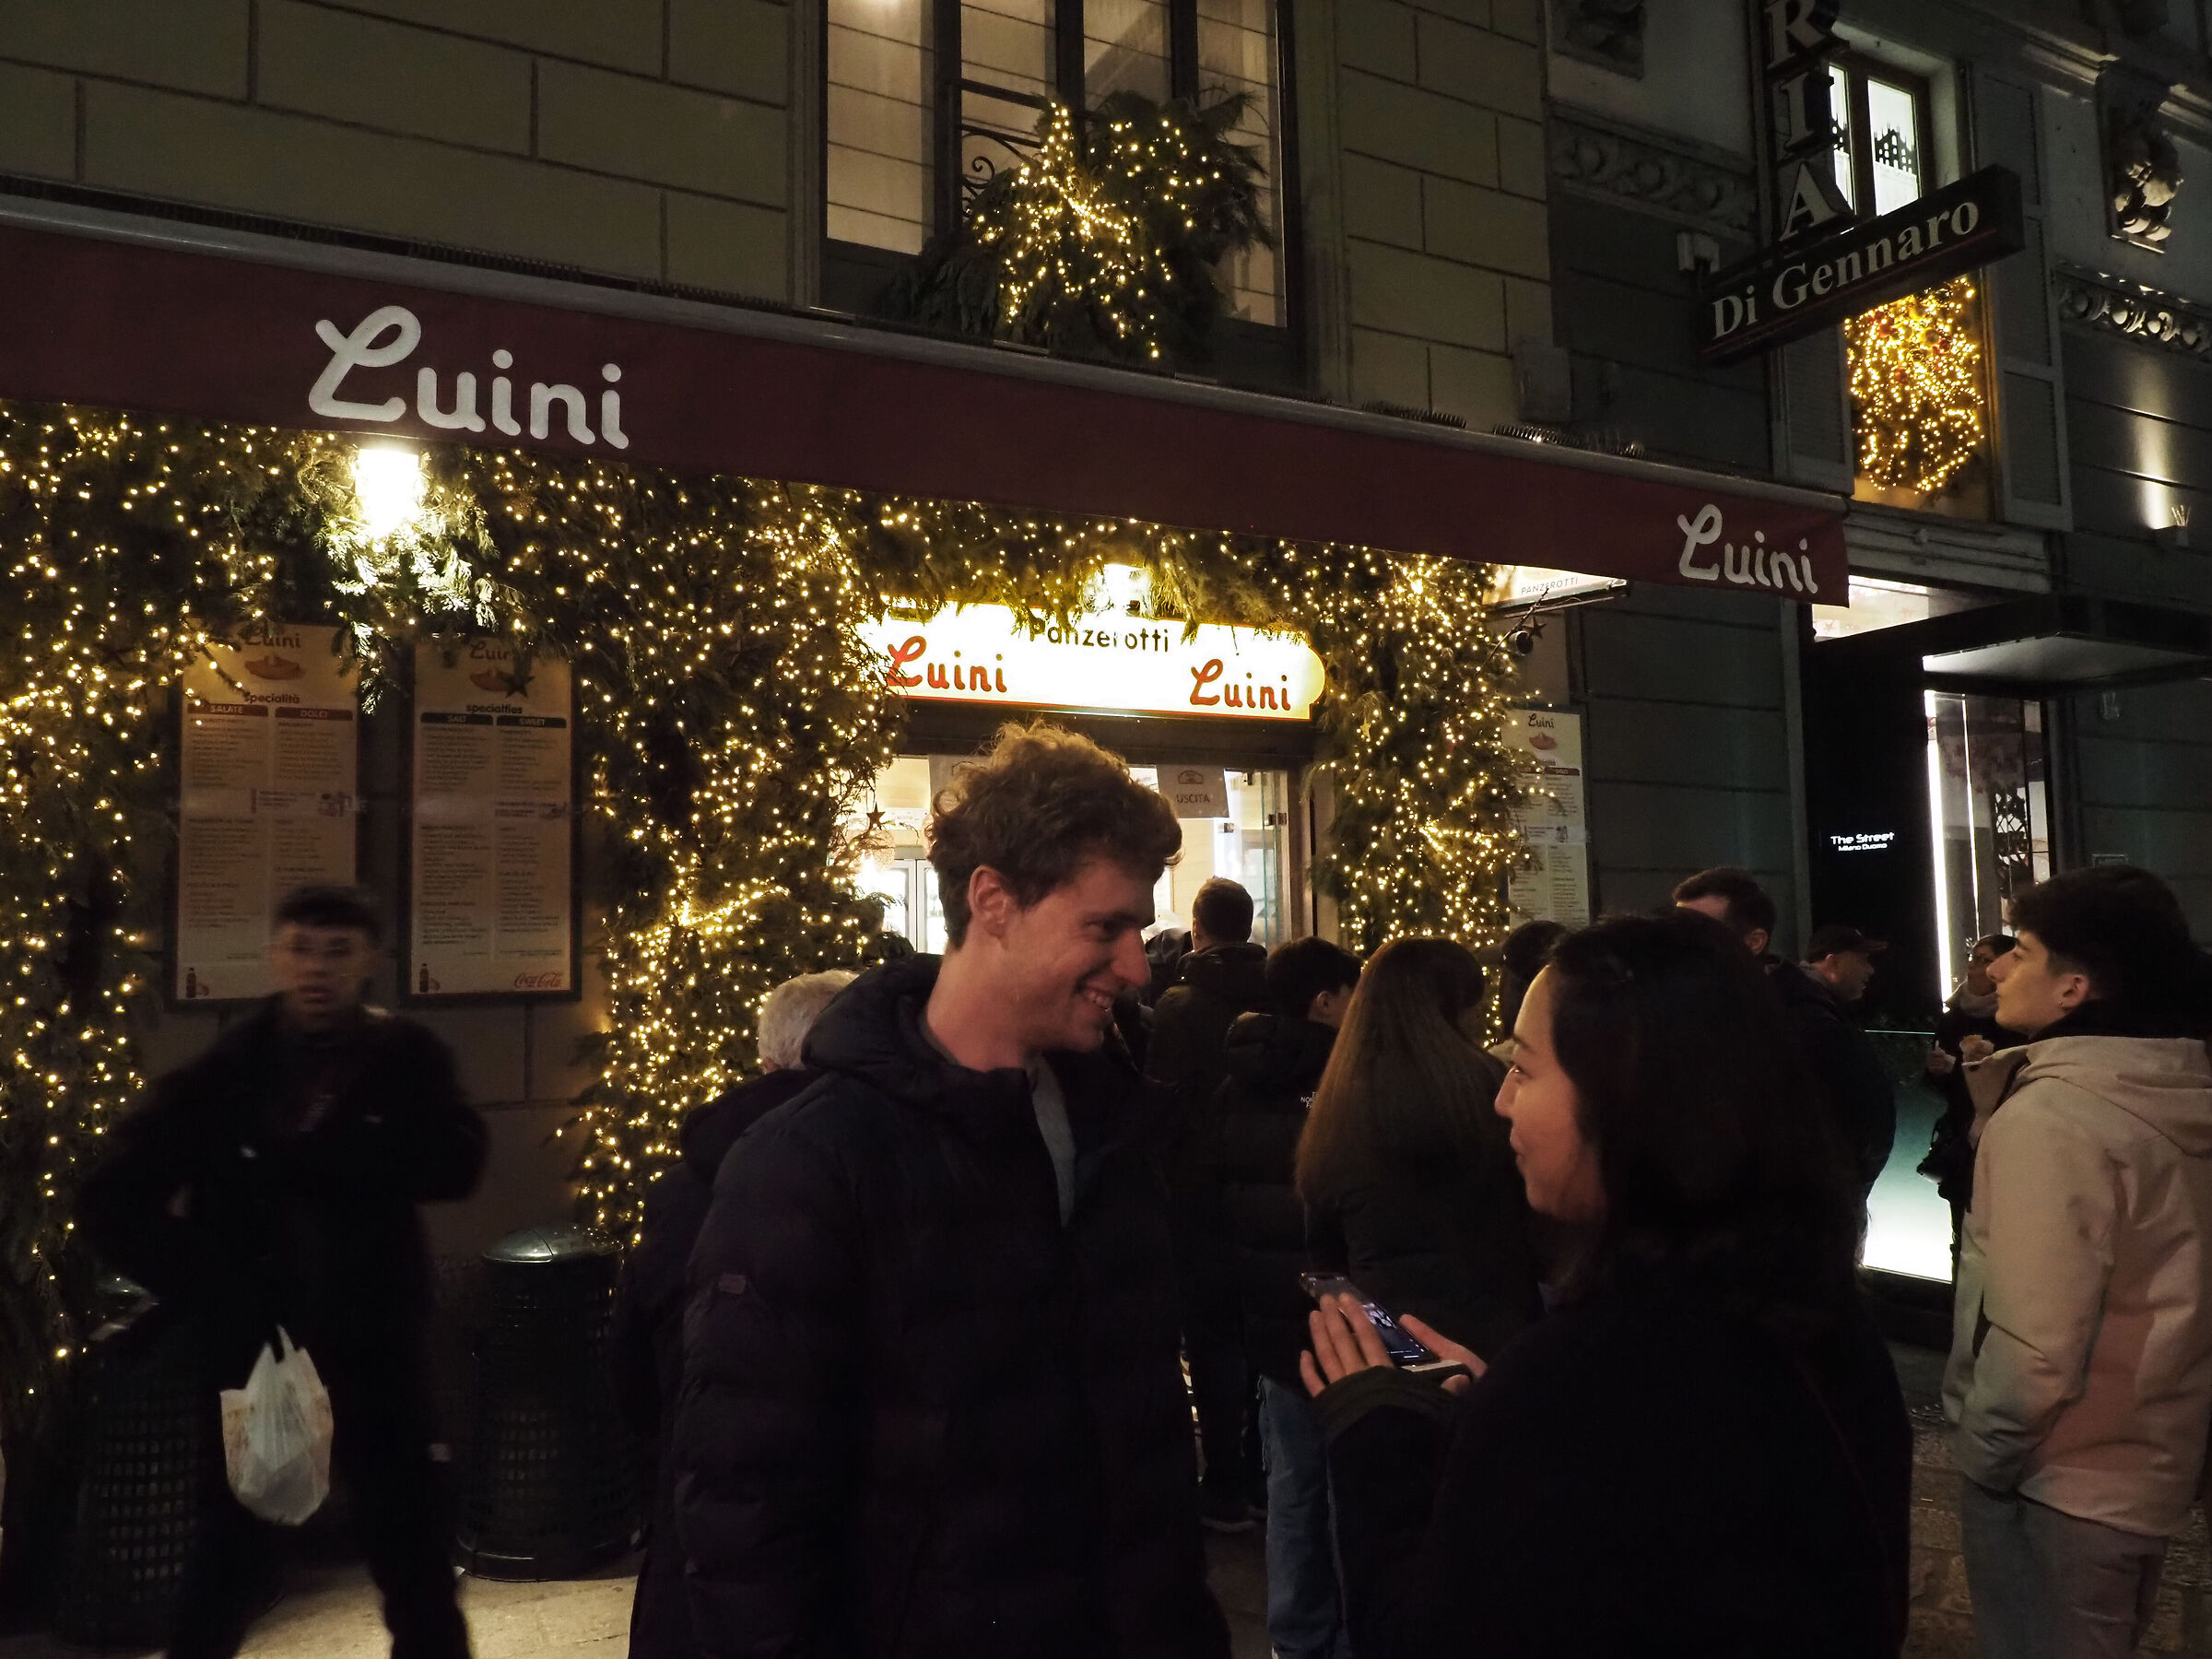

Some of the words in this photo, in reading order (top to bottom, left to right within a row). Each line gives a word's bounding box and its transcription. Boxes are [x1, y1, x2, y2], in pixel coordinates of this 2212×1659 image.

[1712, 285, 1759, 339] Di
[1772, 201, 1980, 311] Gennaro
[309, 305, 629, 450] Luini
[1677, 503, 1818, 594] Luini
[1521, 577, 1579, 594] PANZEROTTI
[887, 635, 1007, 693] Luini
[1189, 658, 1291, 712] Luini
[1527, 712, 1555, 729] Luini
[1176, 794, 1210, 805] USCITA
[1830, 835, 1854, 845] The
[1855, 831, 1895, 843] Street
